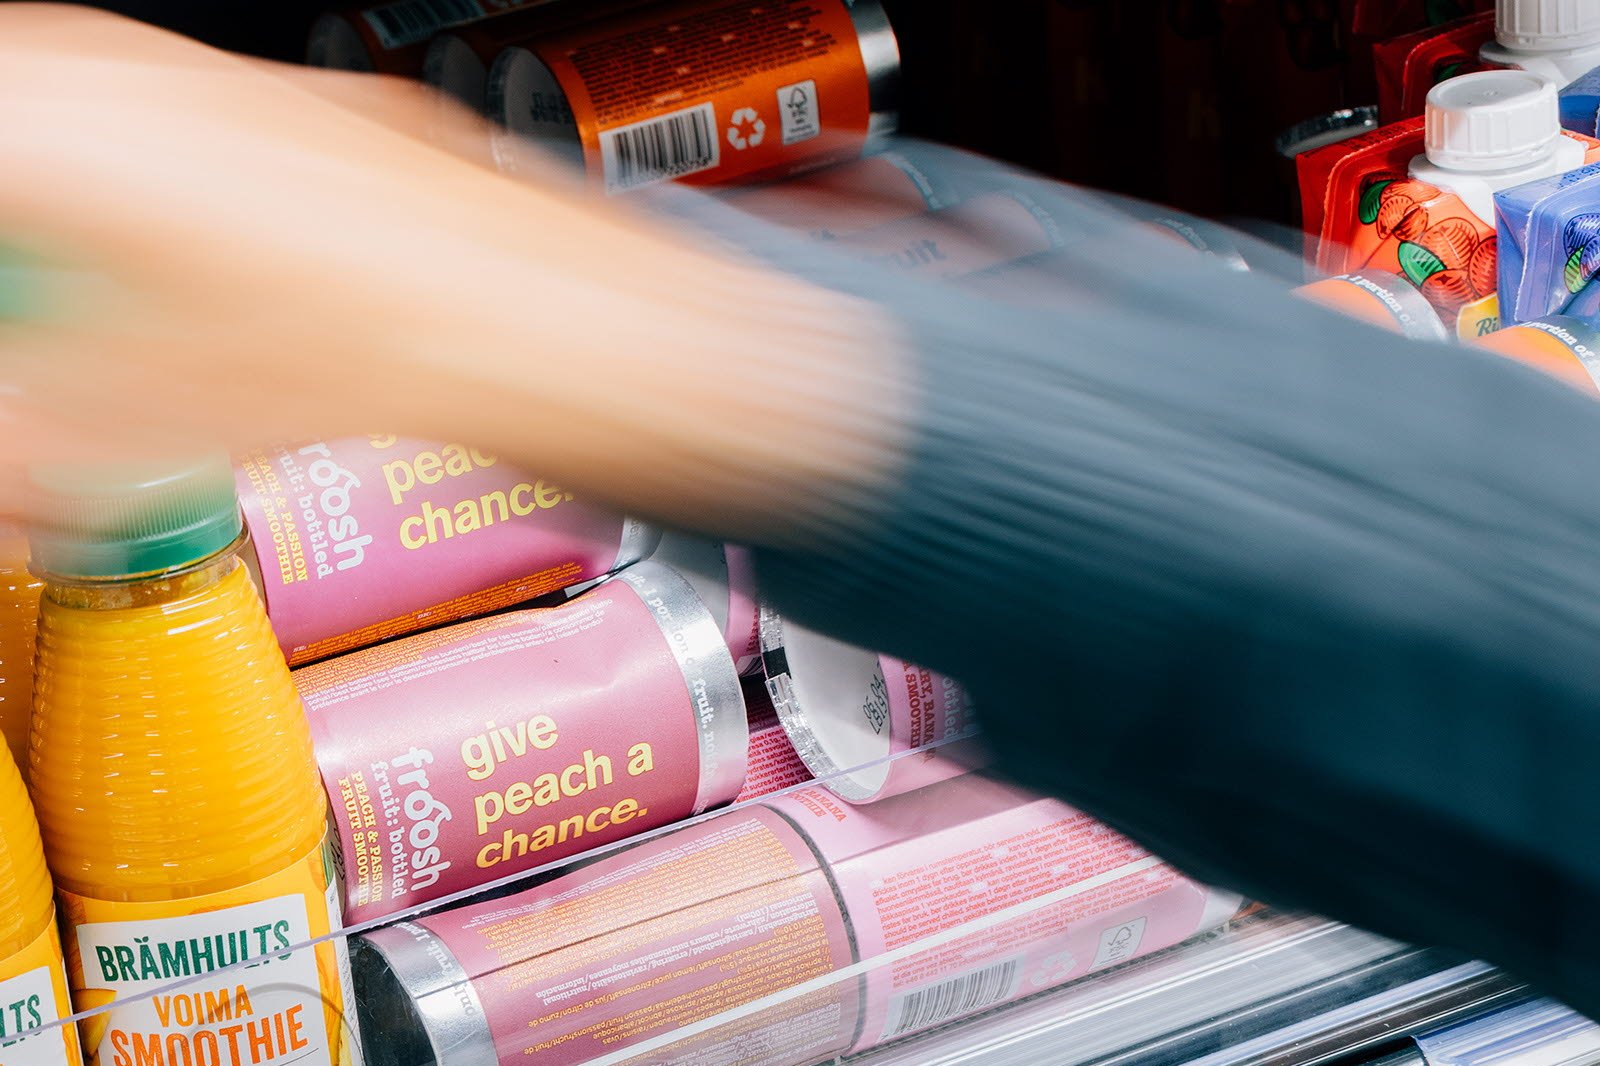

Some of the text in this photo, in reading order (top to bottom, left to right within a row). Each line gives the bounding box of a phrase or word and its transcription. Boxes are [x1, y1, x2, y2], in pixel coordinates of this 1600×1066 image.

[260, 497, 294, 585] SMOOTHIE
[281, 511, 308, 582] PASSION
[300, 492, 333, 580] bottled
[461, 714, 559, 781] give
[392, 747, 452, 891] froosh
[475, 742, 654, 835] peach a
[338, 777, 369, 907] FRUIT SMOOTHIE
[351, 771, 382, 902] PEACH PASSION
[389, 826, 408, 898] bottled
[475, 795, 649, 869] chance.
[96, 919, 292, 982] BRÄMHULTS
[153, 984, 254, 1027] VOIMA
